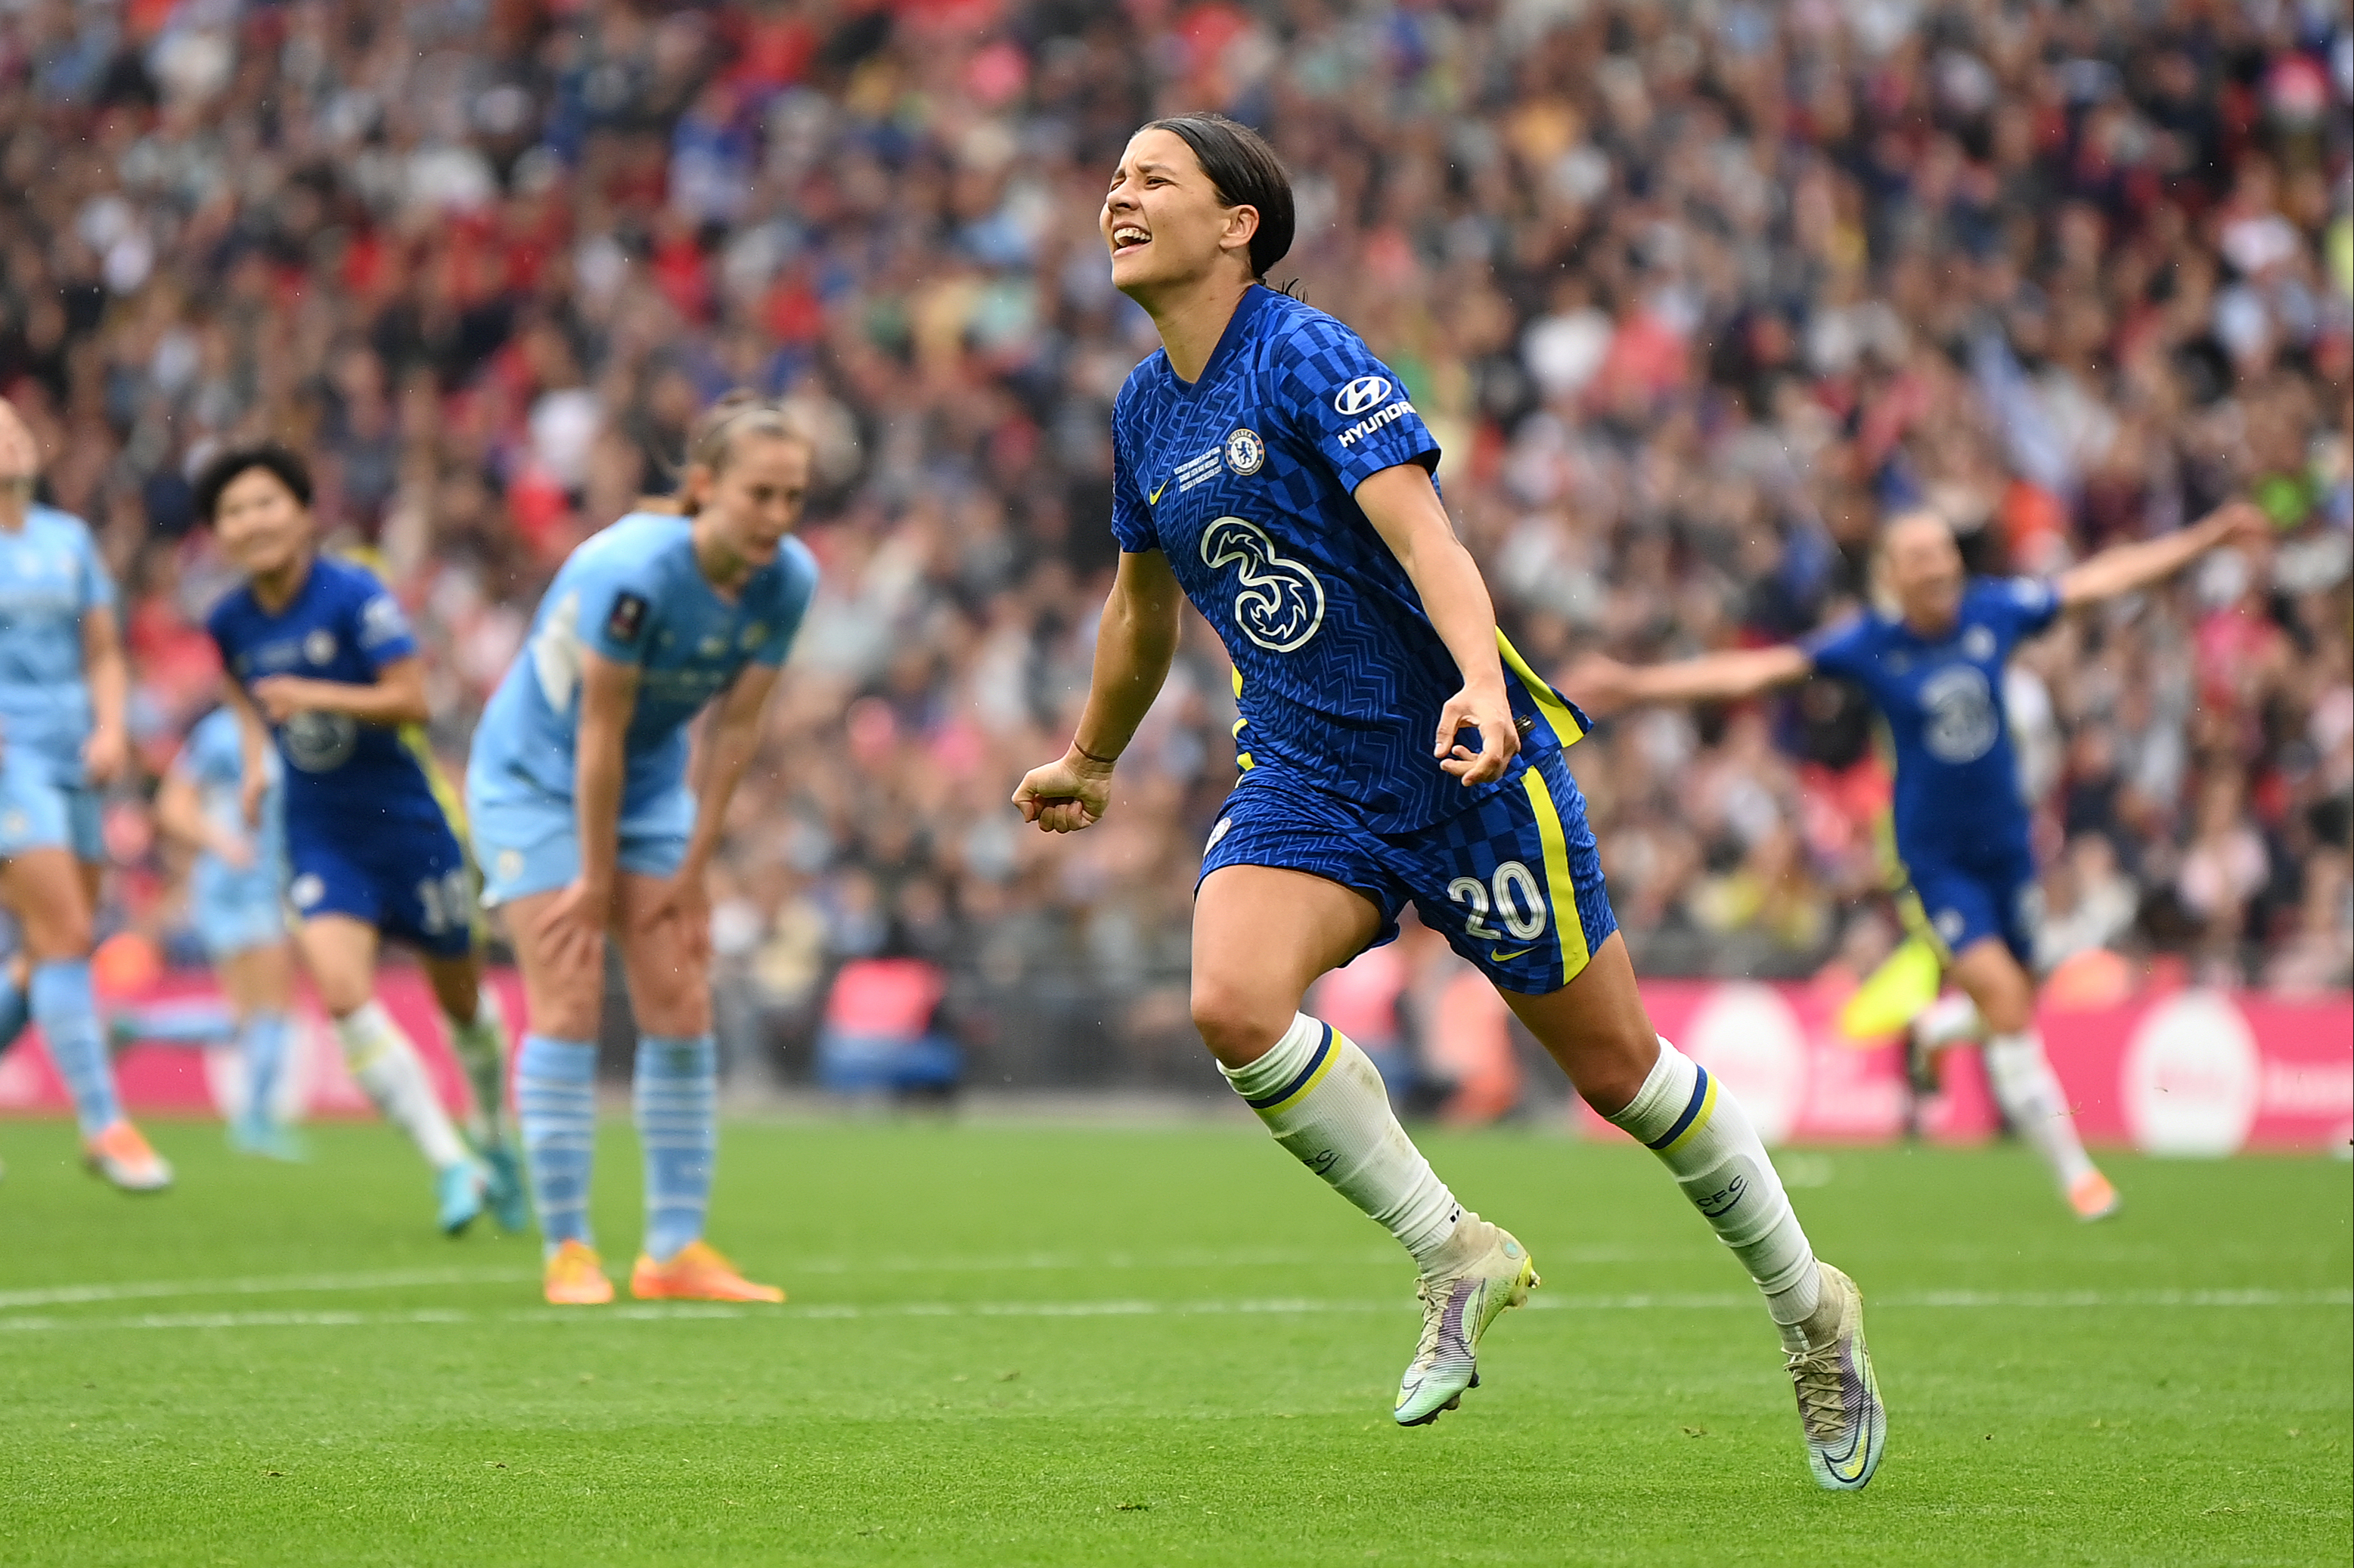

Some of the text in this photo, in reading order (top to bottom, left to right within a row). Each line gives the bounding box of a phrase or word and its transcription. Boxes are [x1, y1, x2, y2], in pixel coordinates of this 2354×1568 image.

[1228, 430, 1252, 445] CHELSEA
[1200, 516, 1325, 653] 3
[1447, 860, 1547, 941] 20
[1301, 1148, 1335, 1167] FC
[1695, 1174, 1744, 1207] CFC
